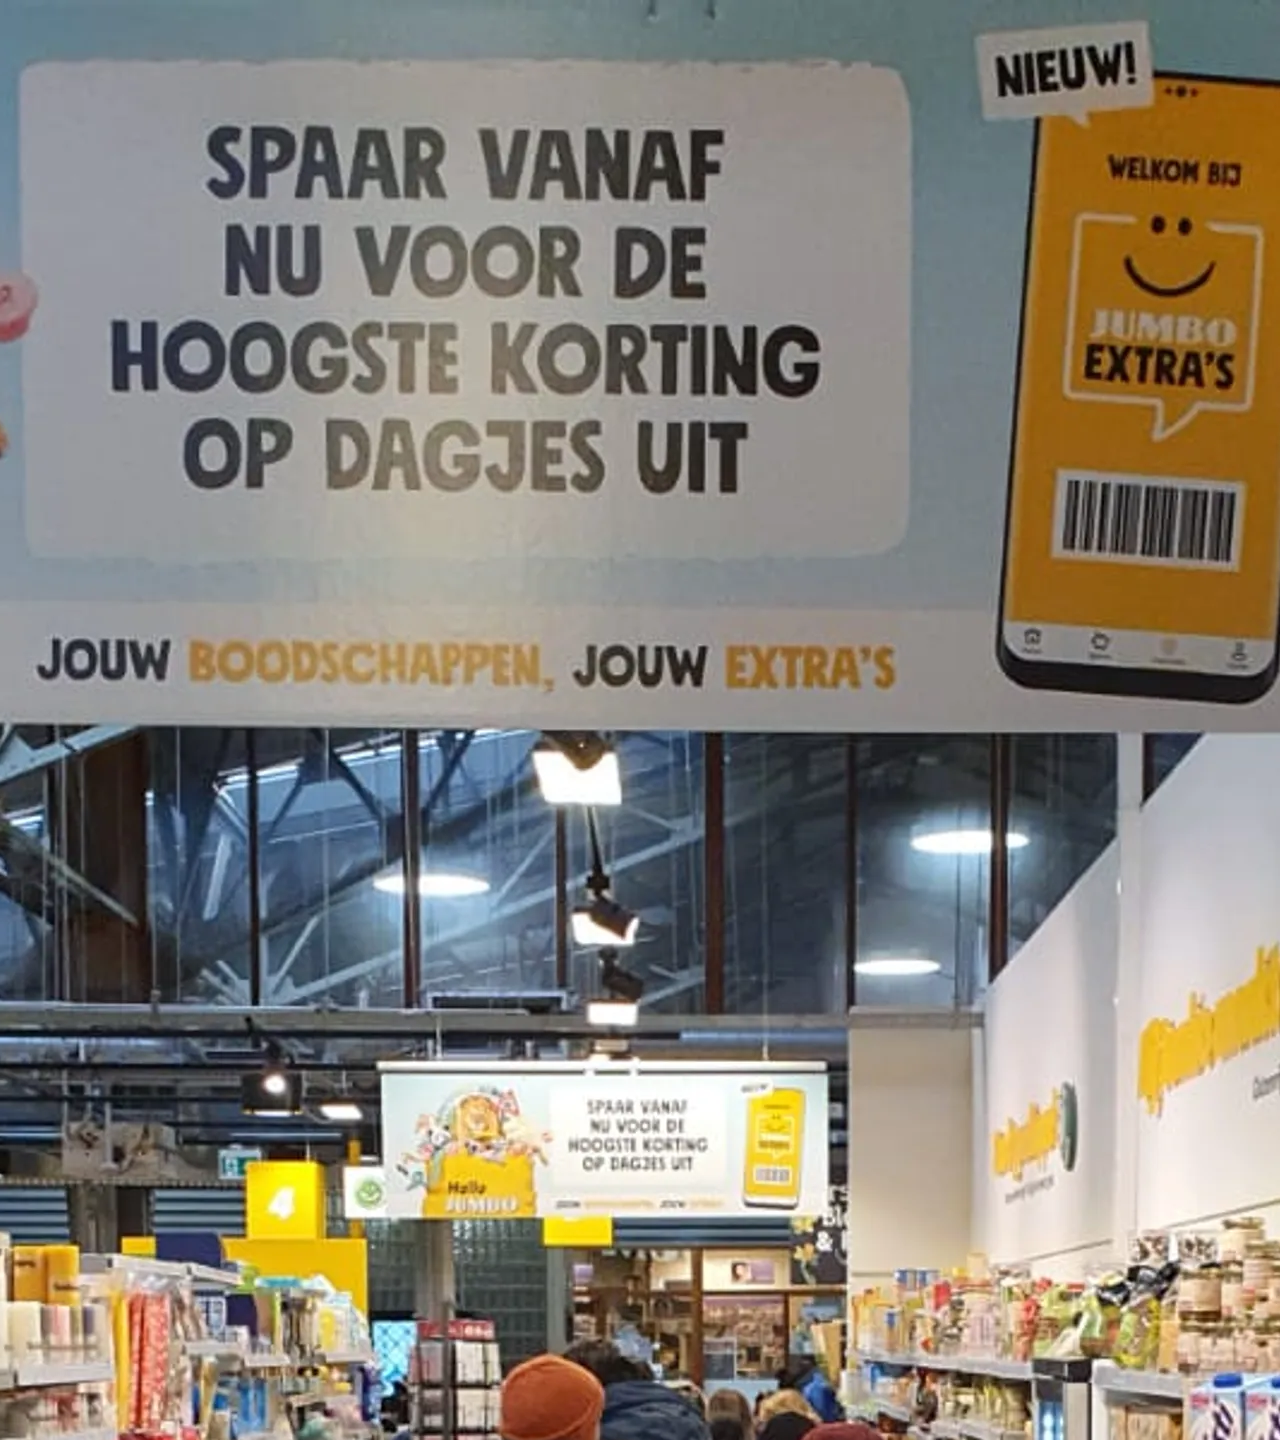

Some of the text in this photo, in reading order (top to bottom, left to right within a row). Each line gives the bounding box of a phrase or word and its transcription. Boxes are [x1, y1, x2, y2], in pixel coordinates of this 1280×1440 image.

[995, 41, 1137, 97] NIEUW!
[207, 126, 724, 202] SPAAR VANAF
[1108, 154, 1242, 187] WELKOM BIJ
[225, 224, 707, 299] NU VOOR DE
[1090, 308, 1237, 347] JUMBO
[110, 320, 820, 397] HOOGSTE KORTING
[1084, 343, 1234, 390] EXTRA'S
[183, 418, 748, 494] OP DAGJES UIT
[37, 638, 896, 693] JOUW BOODSCHAPPEN, JOUW EXTRA'S
[586, 1099, 636, 1115] SPAAR
[616, 1118, 661, 1134] VOOR
[666, 1118, 685, 1134] DE
[568, 1136, 708, 1153] HOOGSTE KORTING
[671, 1156, 693, 1172] UIT
